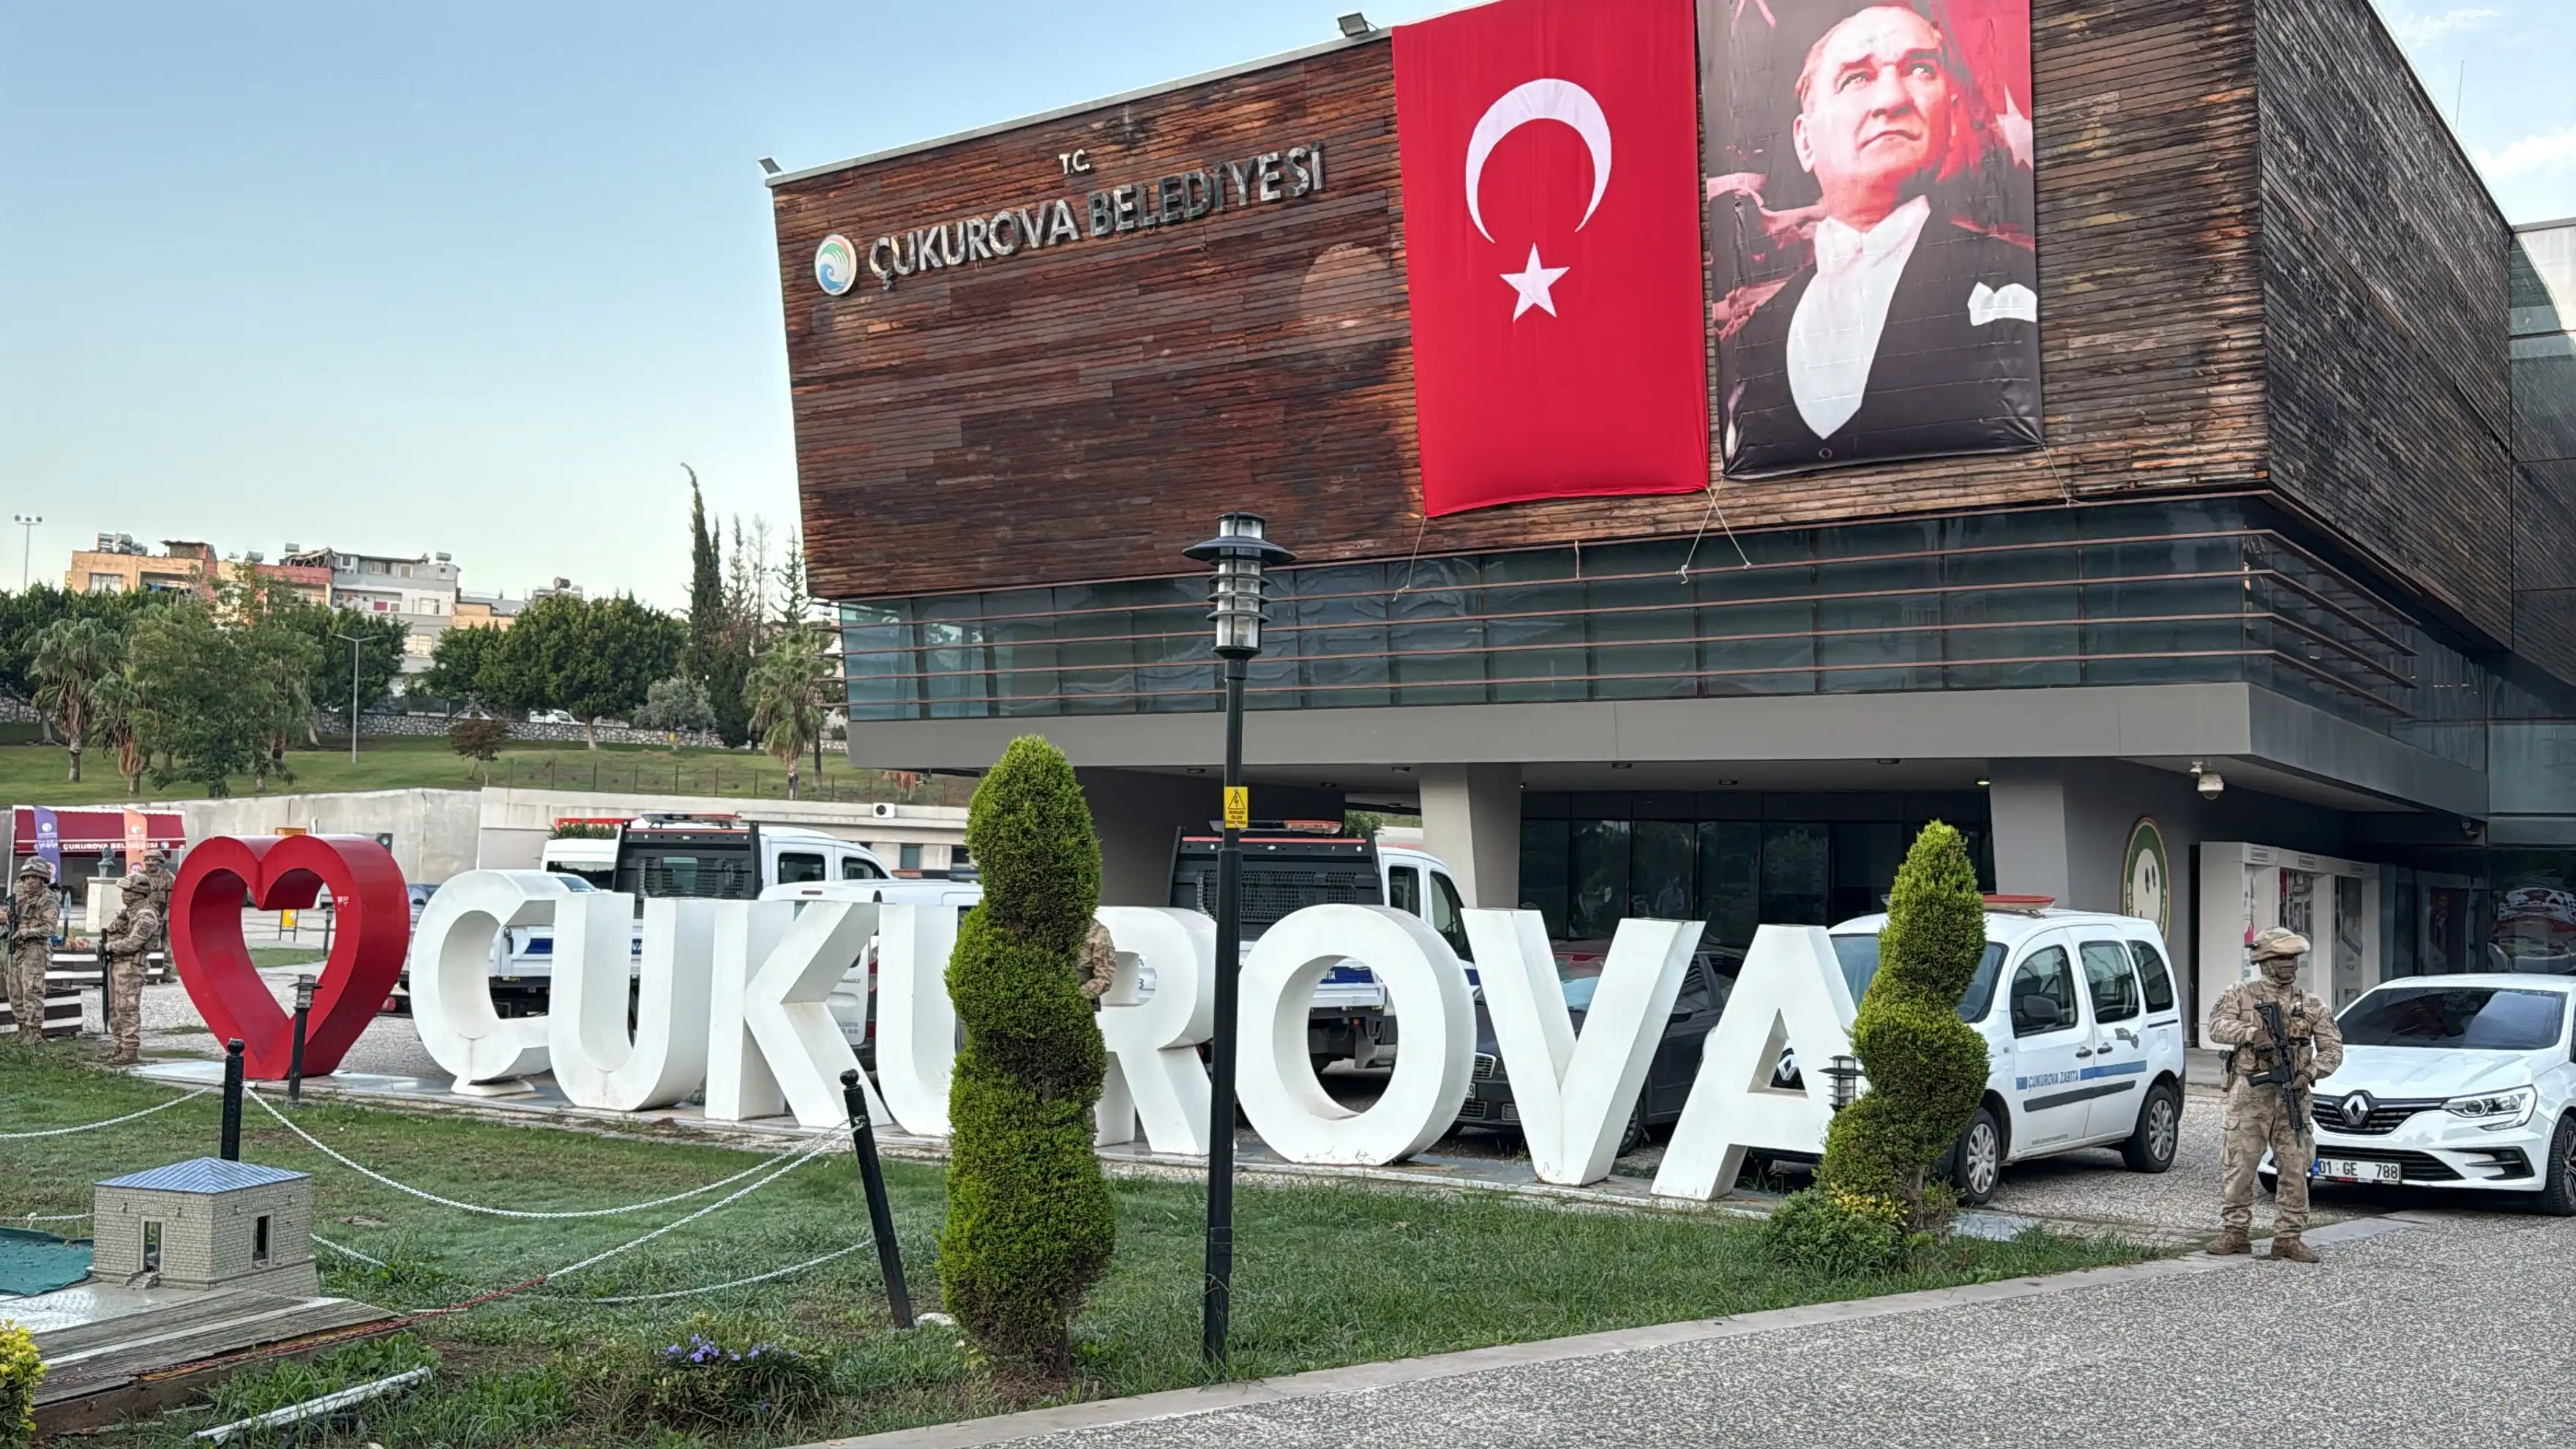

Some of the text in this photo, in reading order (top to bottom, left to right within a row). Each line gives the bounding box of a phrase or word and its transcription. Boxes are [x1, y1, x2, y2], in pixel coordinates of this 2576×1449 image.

[1058, 149, 1090, 176] T.C.
[869, 140, 1325, 291] ÇUKUROVA BELEDİYESİ
[2028, 1069, 2078, 1093] ÇUKUROVA ZABITA
[2318, 1160, 2399, 1180] 01 GE 788
